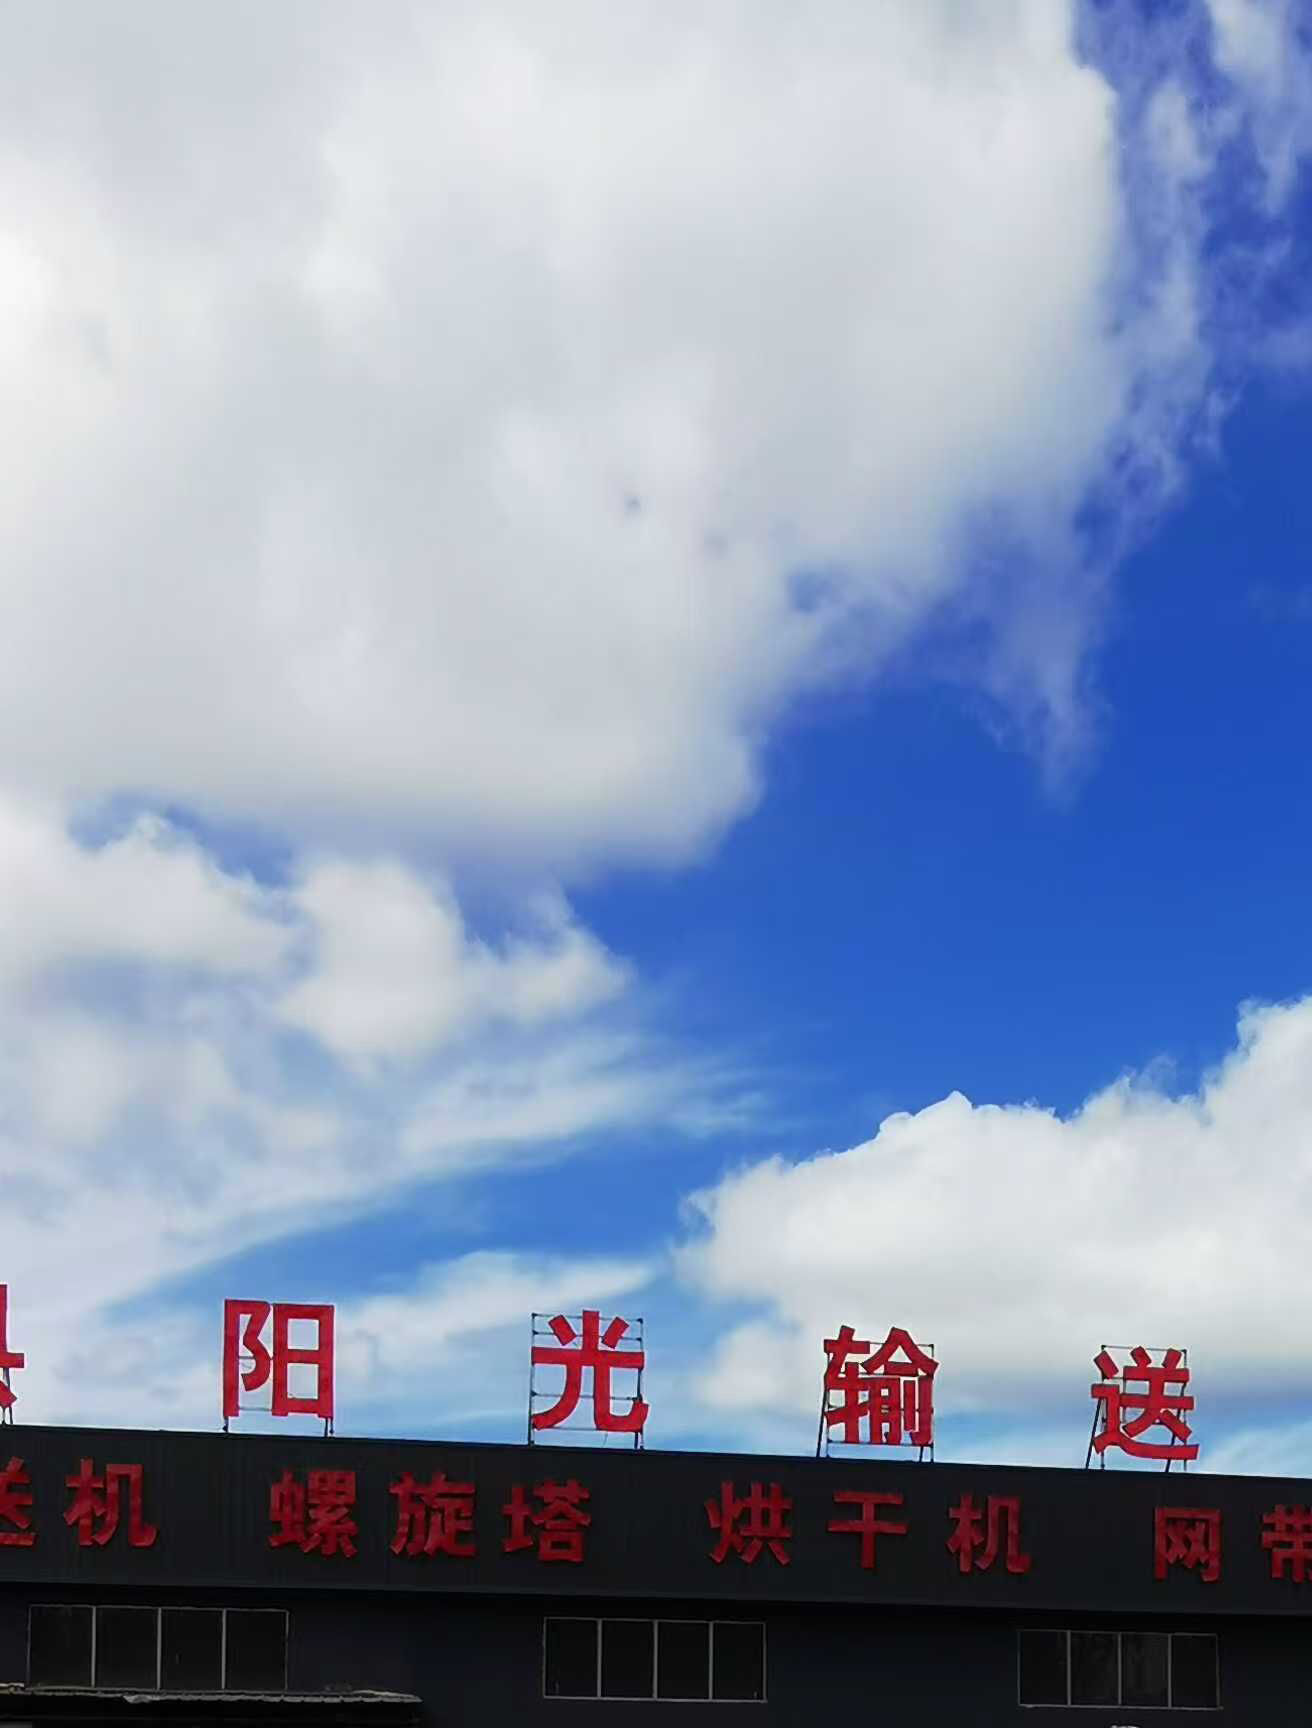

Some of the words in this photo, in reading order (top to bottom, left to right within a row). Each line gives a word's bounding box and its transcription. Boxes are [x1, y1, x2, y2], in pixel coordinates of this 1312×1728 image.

[268, 1470, 591, 1564] 螺旋塔
[704, 1481, 1032, 1574] 烘干机
